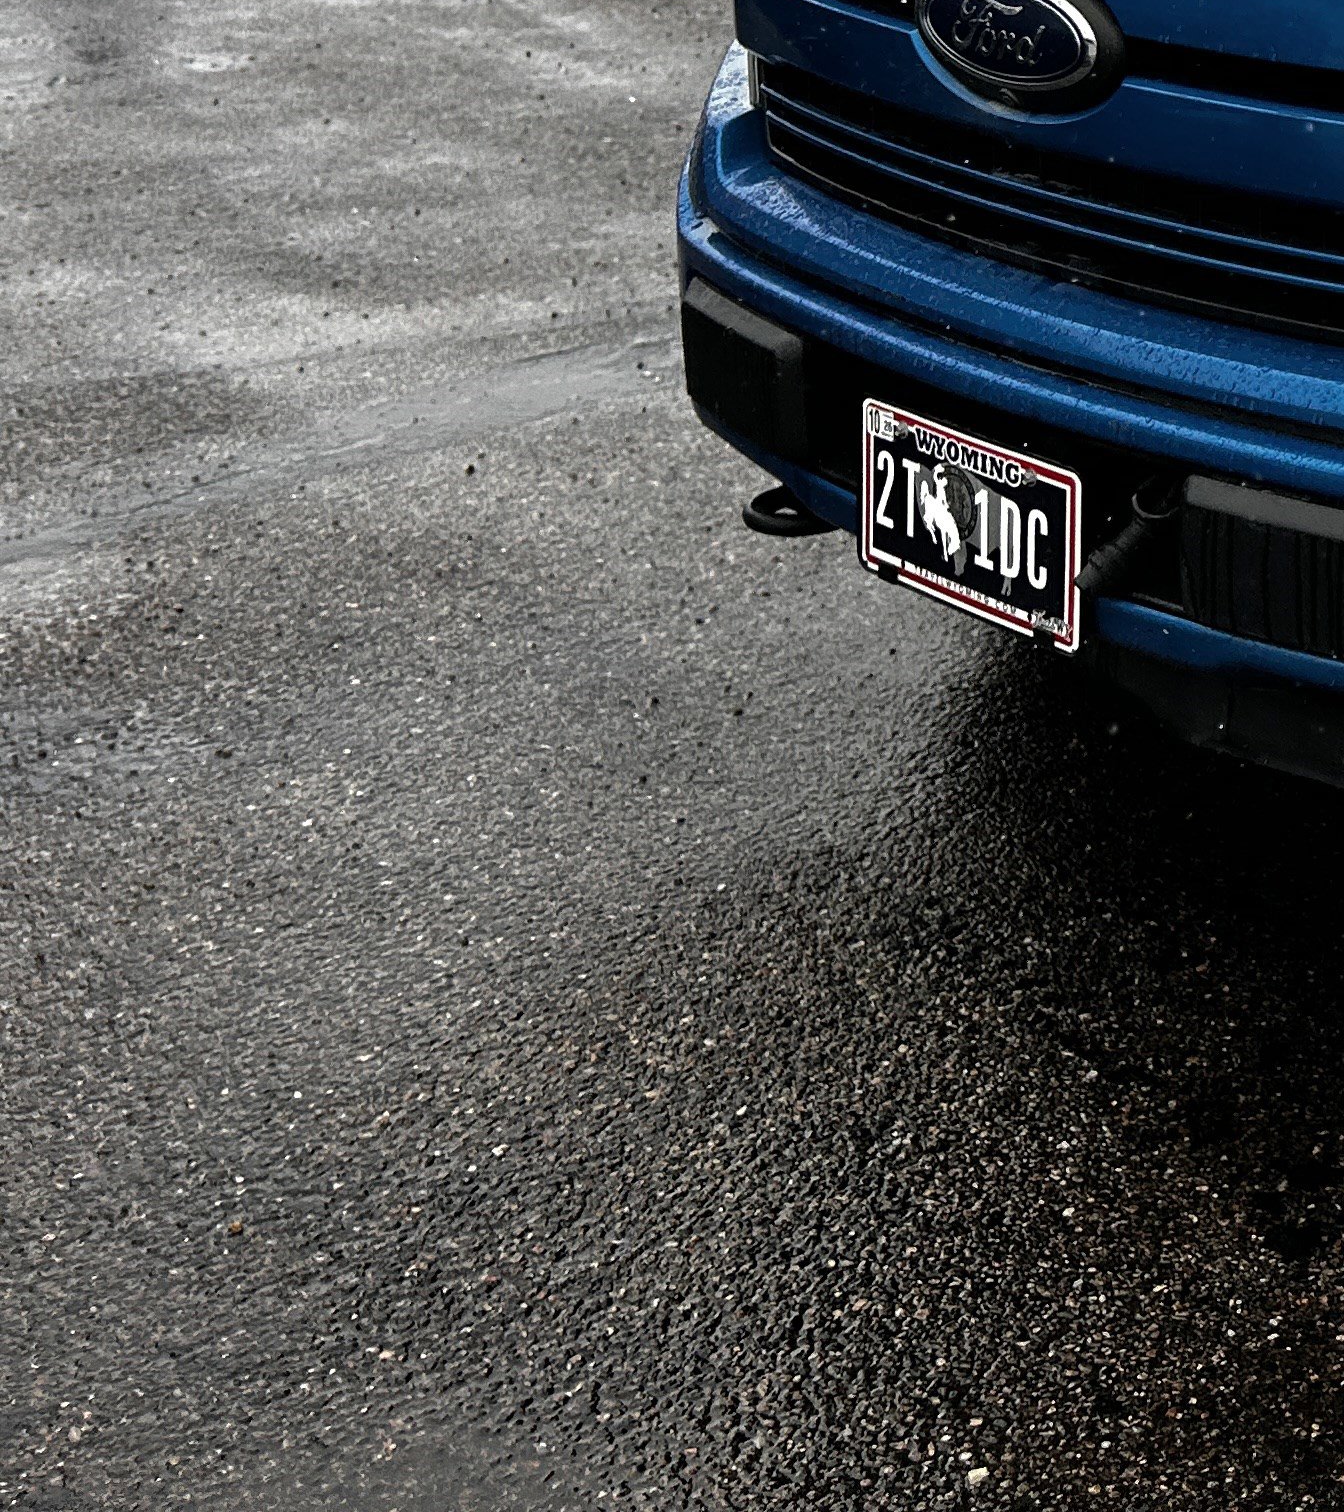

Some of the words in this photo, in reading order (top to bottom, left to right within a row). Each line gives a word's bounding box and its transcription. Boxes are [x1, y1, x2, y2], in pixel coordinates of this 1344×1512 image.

[868, 408, 881, 434] 10
[914, 427, 1022, 487] WYOMING
[876, 450, 921, 538] 2T
[974, 489, 1049, 590] 1DC
